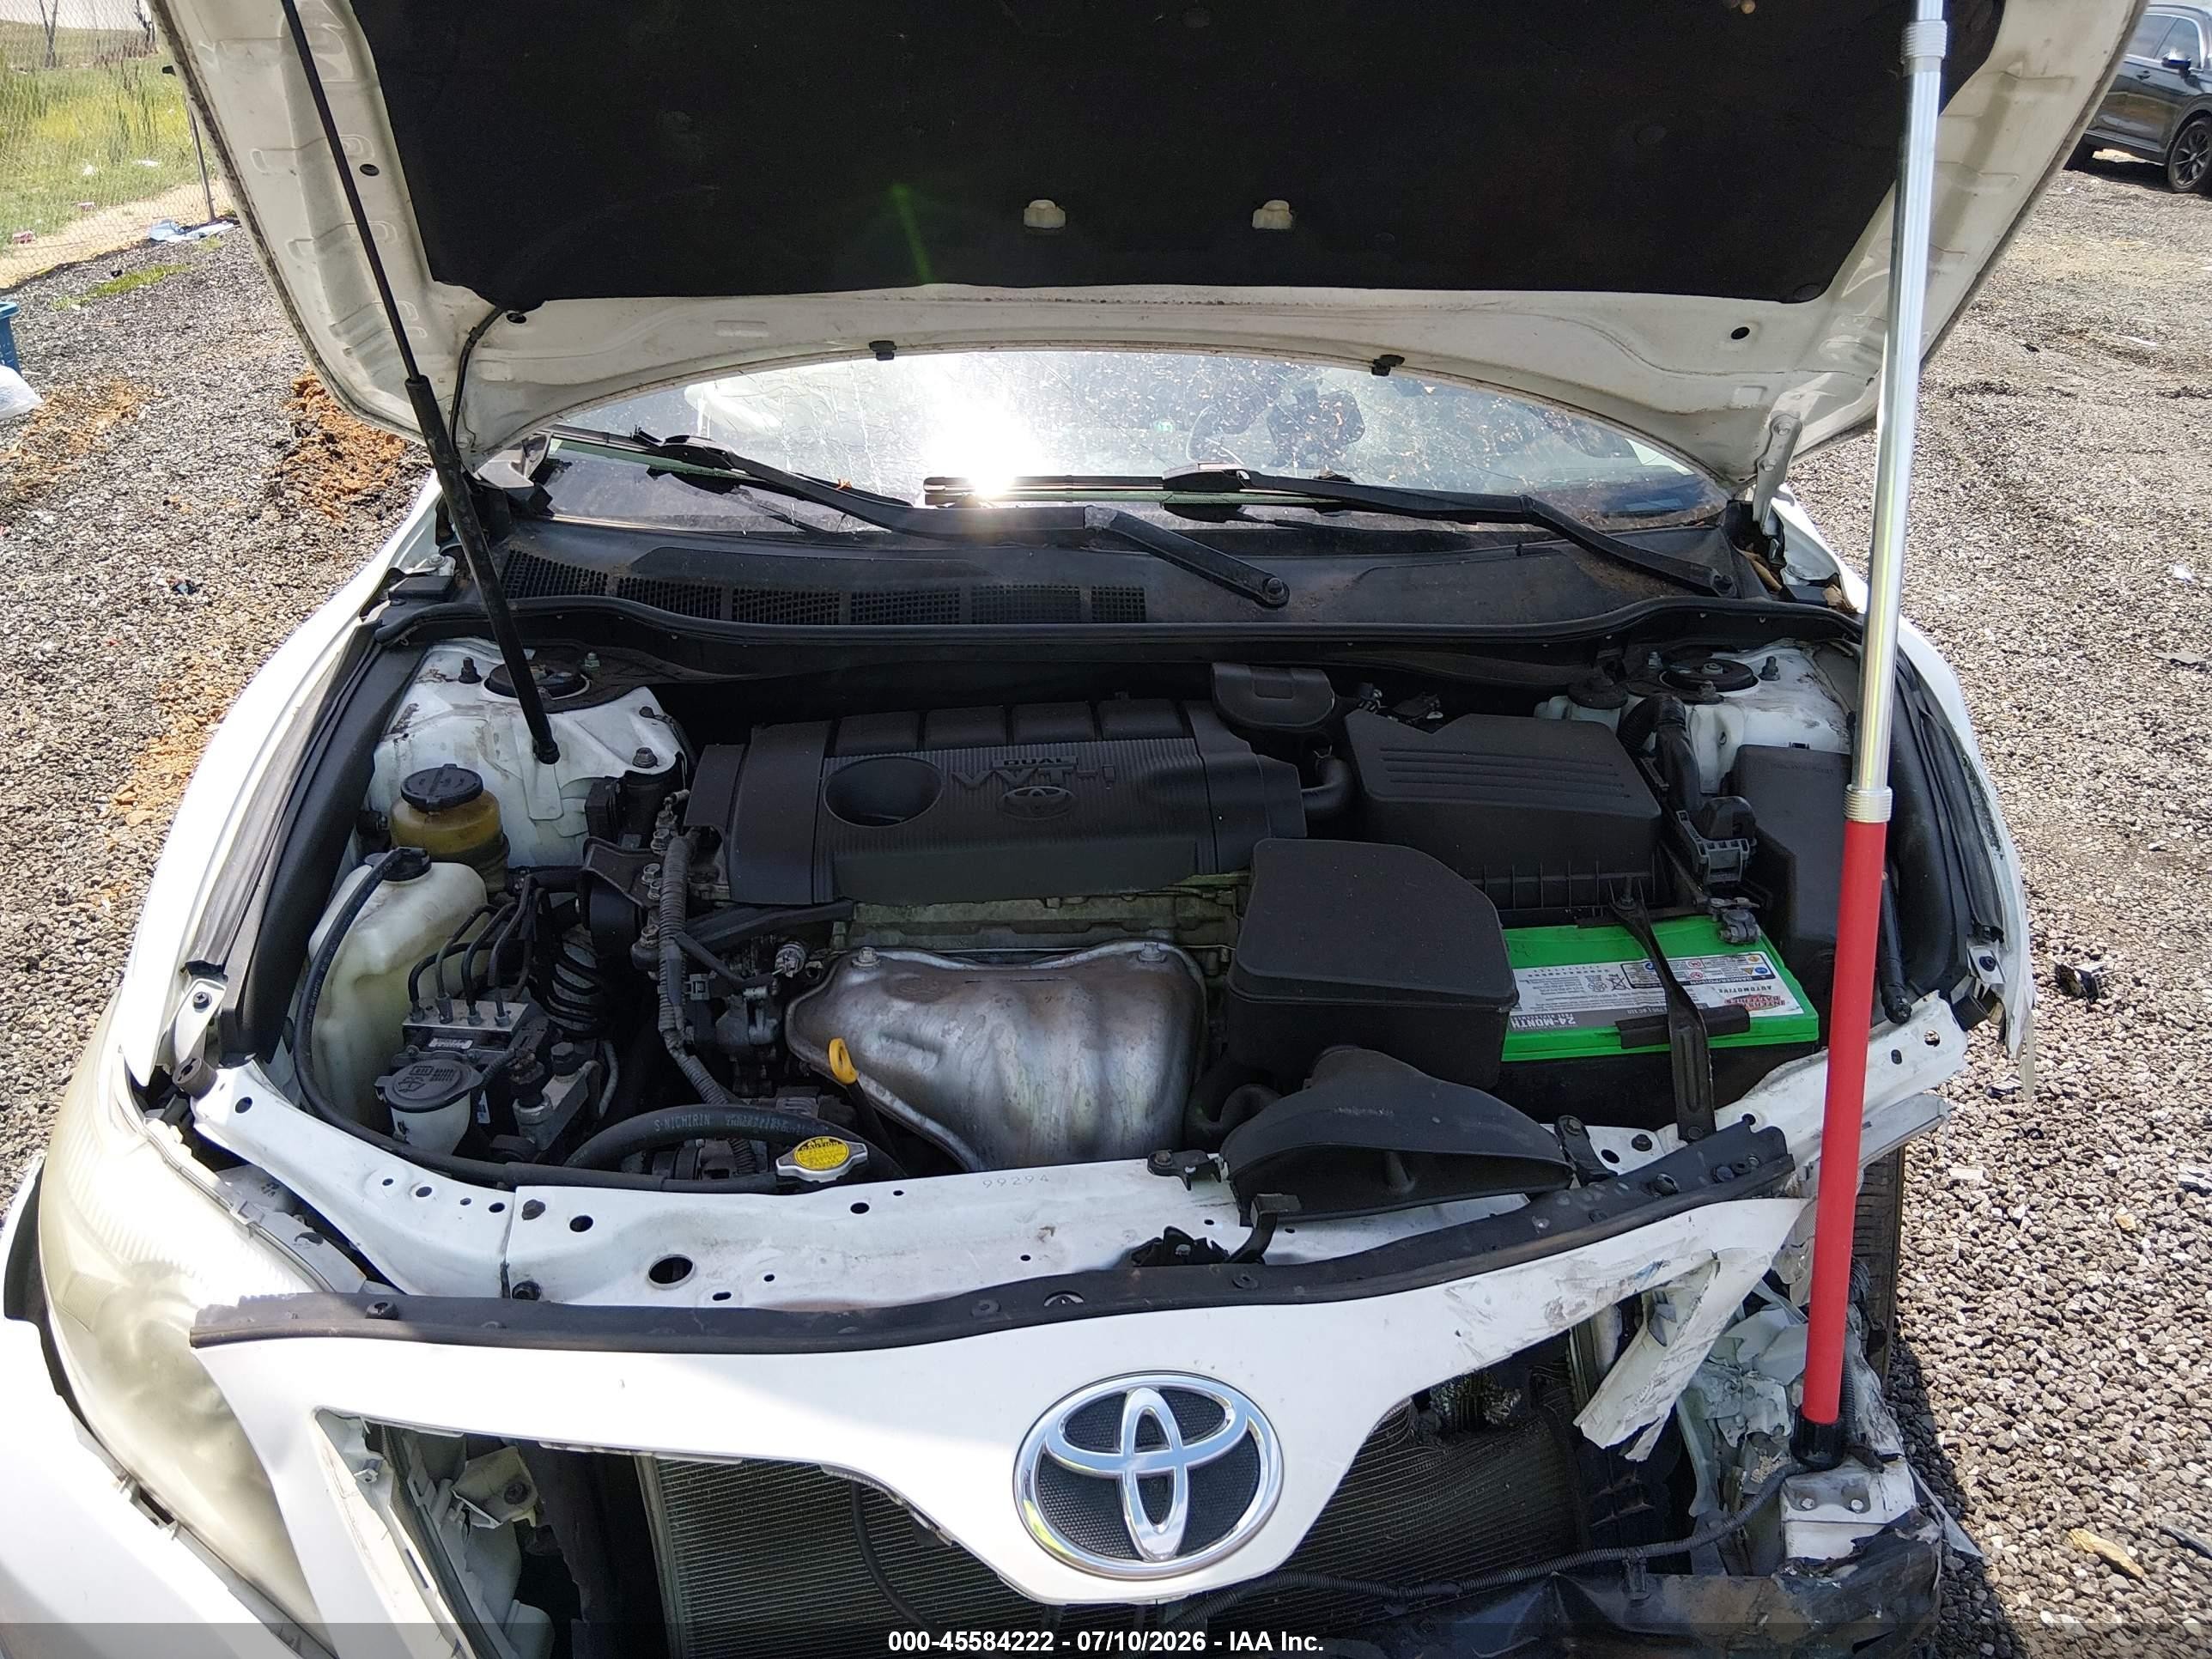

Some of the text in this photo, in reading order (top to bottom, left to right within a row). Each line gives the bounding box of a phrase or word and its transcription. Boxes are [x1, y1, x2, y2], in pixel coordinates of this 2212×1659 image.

[1718, 985, 1772, 994] AUTOMOTIVE
[1510, 1016, 1577, 1029] 24-MONTH
[981, 1174, 1050, 1189] 99294
